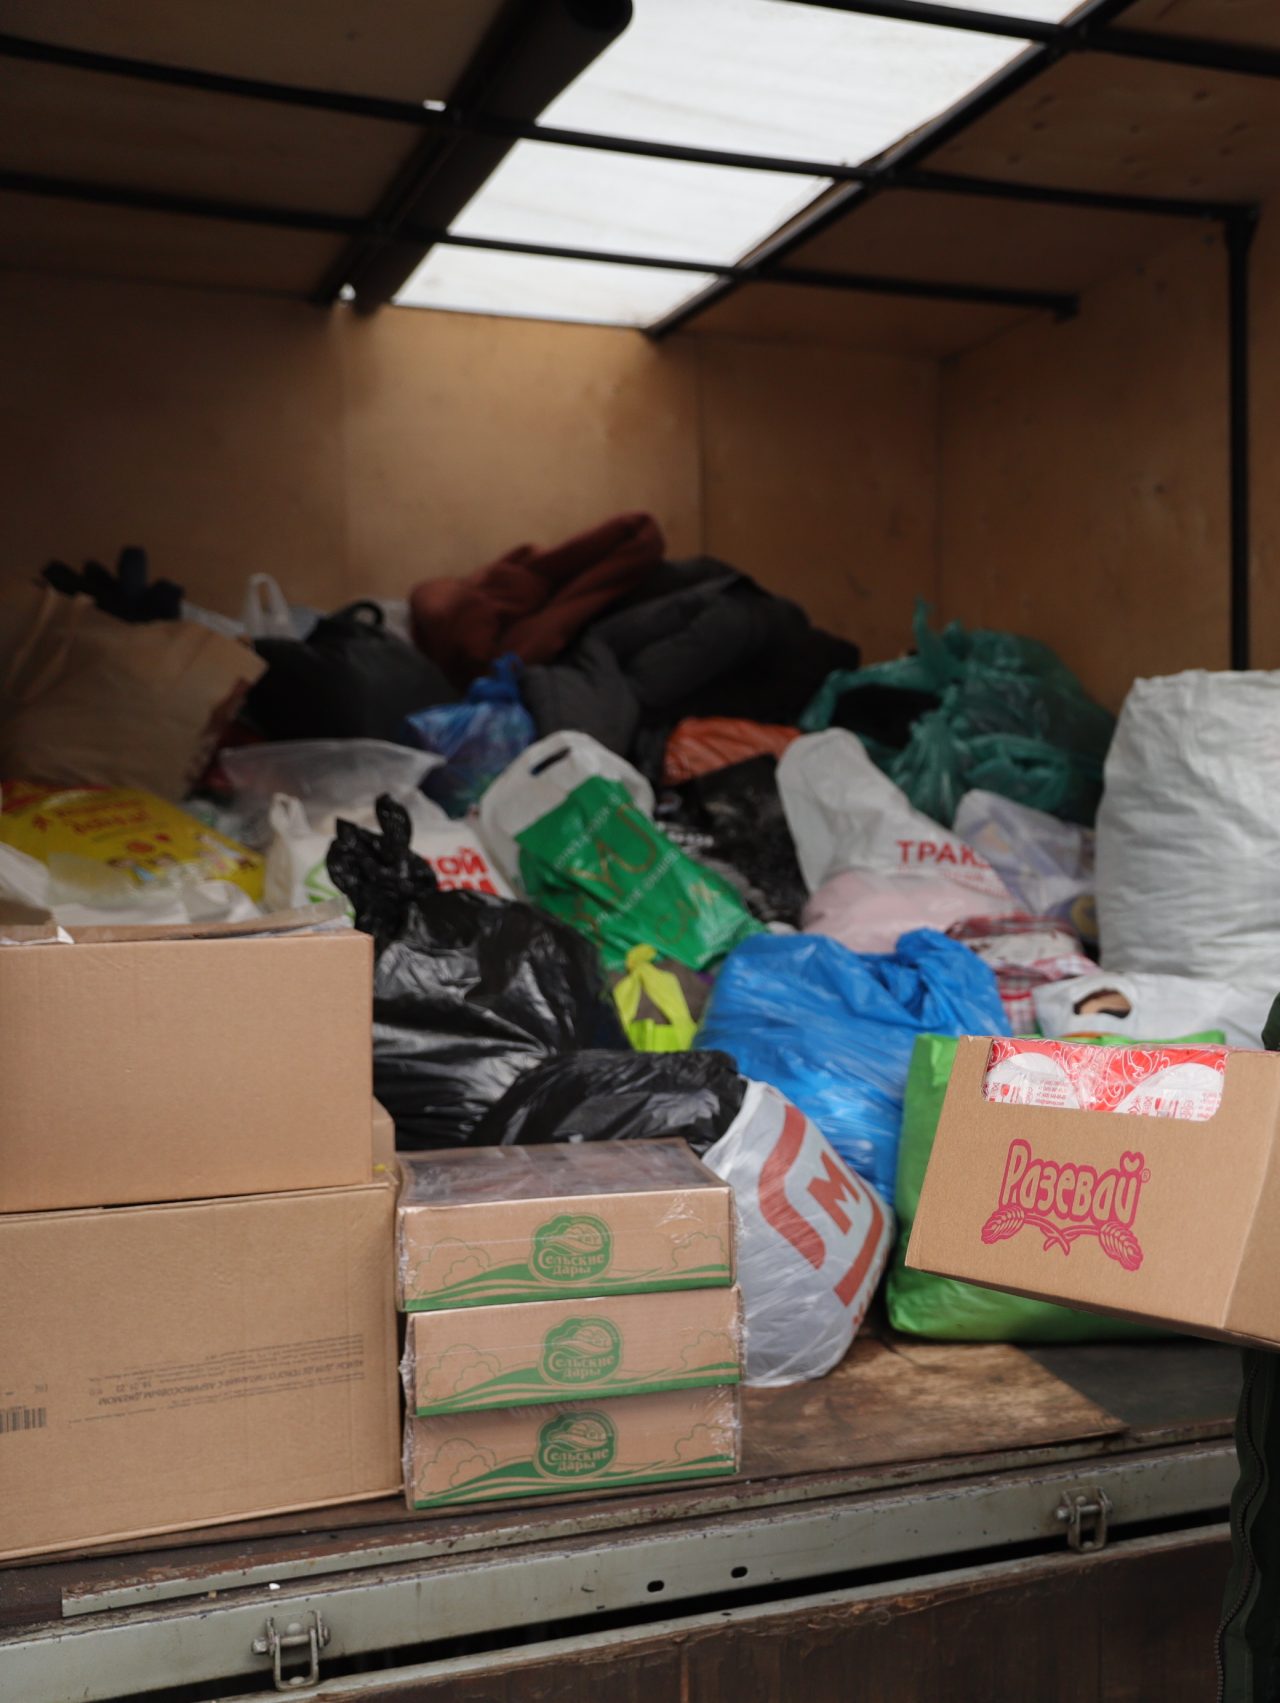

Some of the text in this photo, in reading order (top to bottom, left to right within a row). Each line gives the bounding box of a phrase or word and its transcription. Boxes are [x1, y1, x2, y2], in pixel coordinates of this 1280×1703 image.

[425, 846, 489, 876] ОЙ
[999, 1138, 1145, 1229] Разевай
[538, 1247, 605, 1270] Сельские
[548, 1351, 615, 1372] Сельские
[543, 1444, 609, 1465] Сельские
